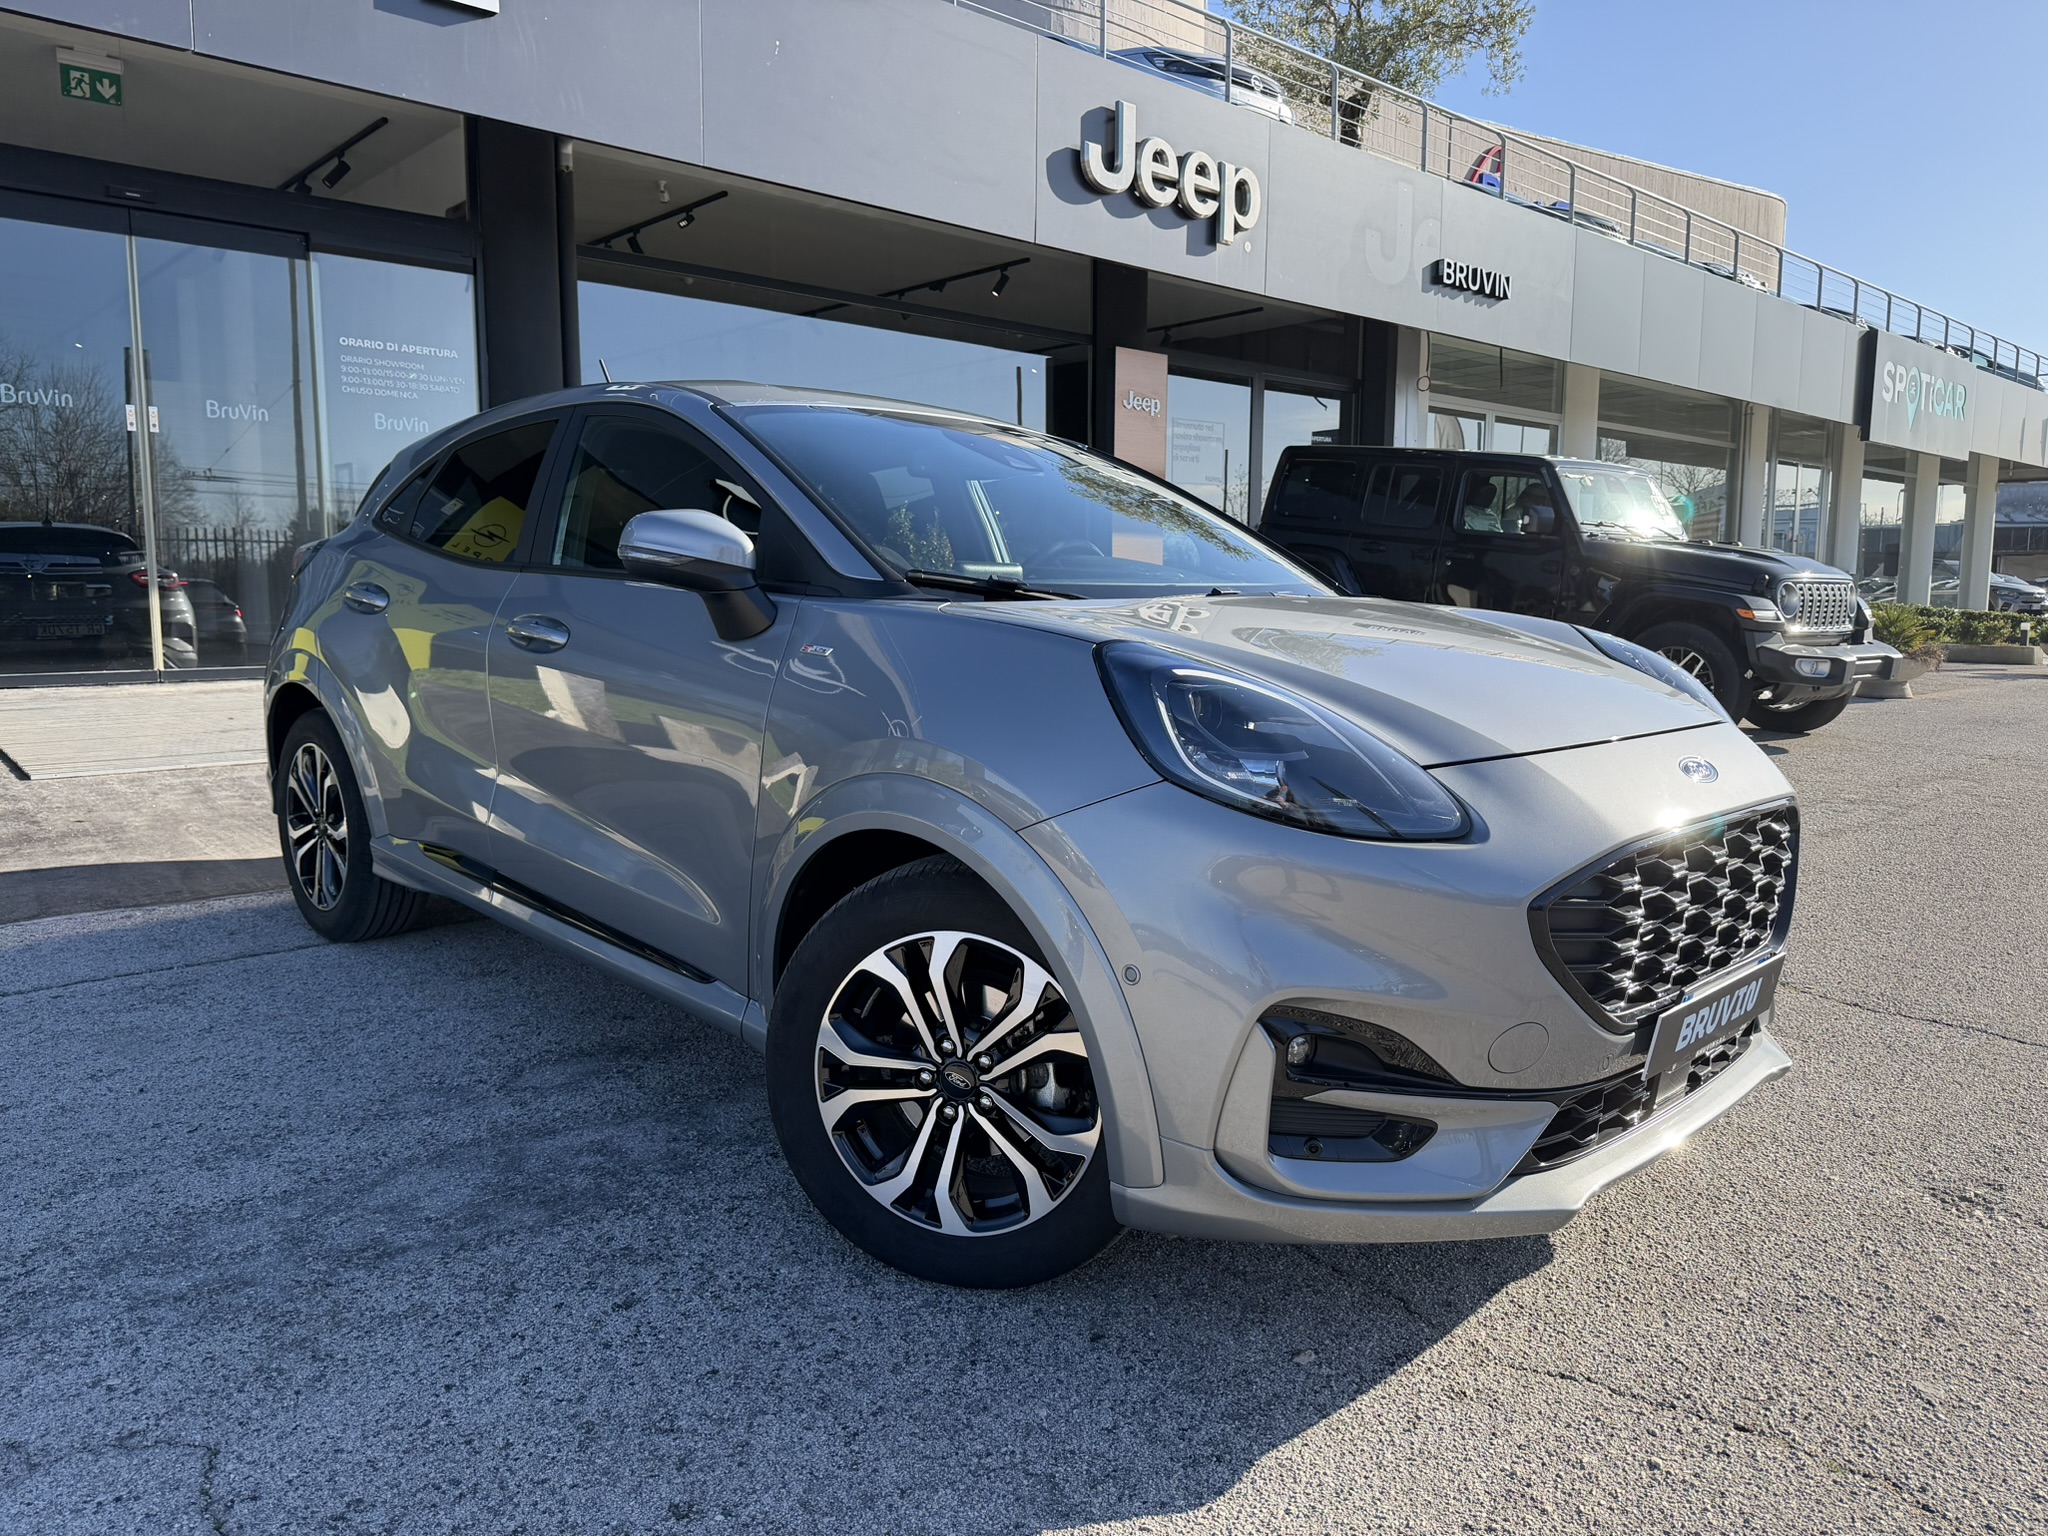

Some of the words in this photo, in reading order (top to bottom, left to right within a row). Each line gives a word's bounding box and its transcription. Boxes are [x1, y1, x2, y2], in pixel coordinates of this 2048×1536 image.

[1080, 100, 1262, 246] Jeep
[1442, 257, 1513, 300] BRUVIN
[339, 336, 384, 350] ORARIO
[386, 342, 399, 352] DI
[401, 343, 459, 359] APERTURA
[340, 355, 373, 365] ORARIO
[374, 358, 425, 371] SHOWROOM
[0, 383, 74, 408] BruVin
[341, 385, 373, 396] CHIUSO
[429, 383, 460, 395] SABATO
[206, 399, 269, 422] BruVin
[1122, 390, 1161, 417] Jeep
[374, 412, 429, 433] BruVin
